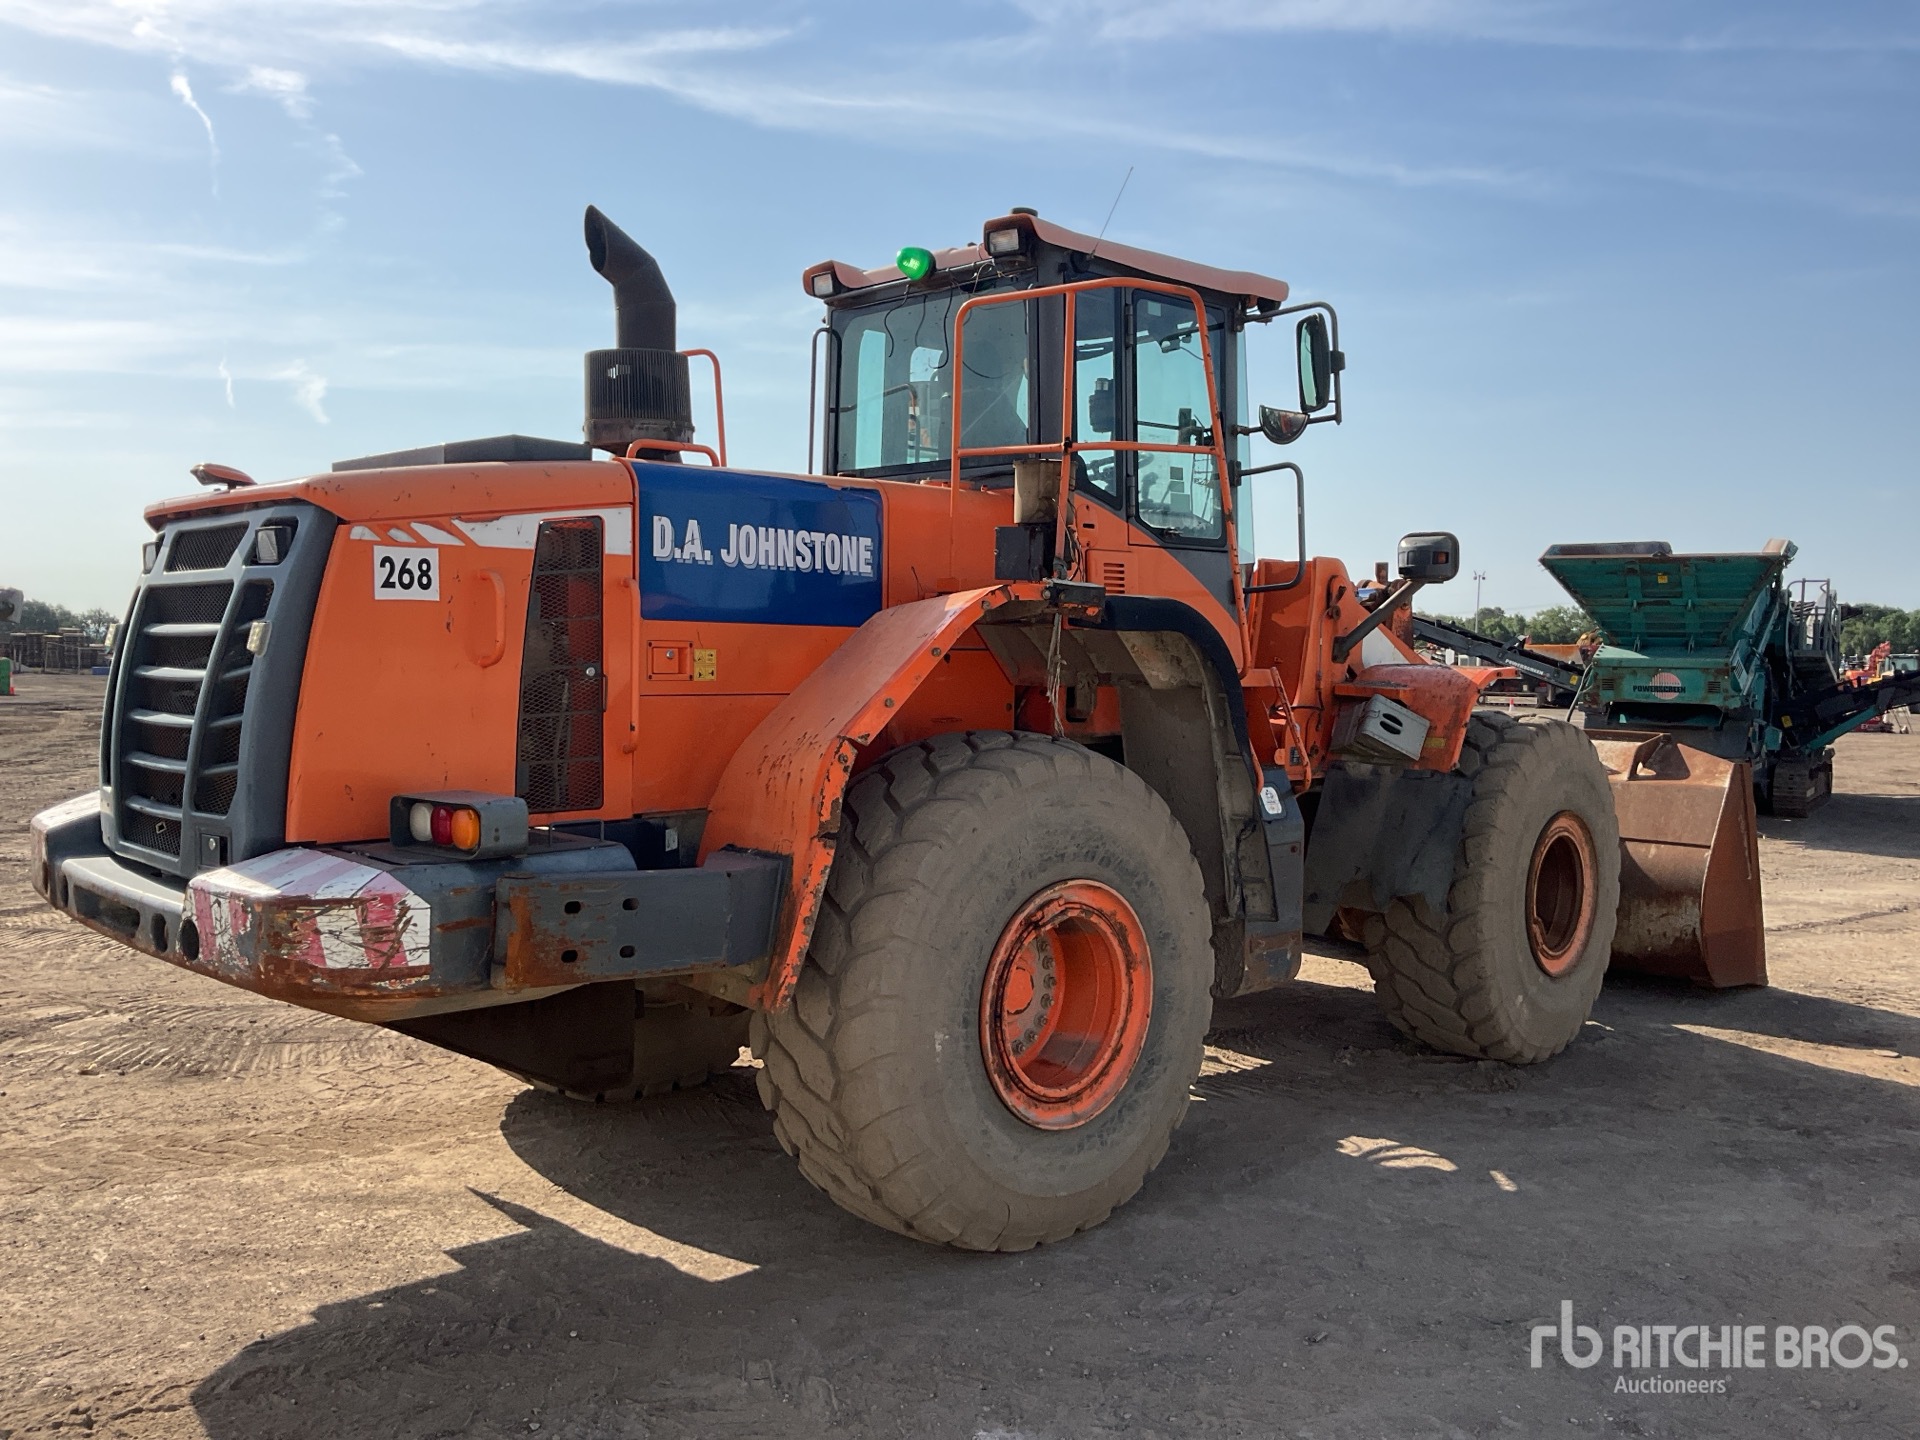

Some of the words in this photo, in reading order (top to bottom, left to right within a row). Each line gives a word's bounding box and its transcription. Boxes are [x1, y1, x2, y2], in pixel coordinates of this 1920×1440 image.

[652, 515, 713, 565] D.A.
[720, 523, 873, 578] JOHNSTONE
[379, 555, 432, 591] 268
[1632, 684, 1687, 694] POWERSCREEN
